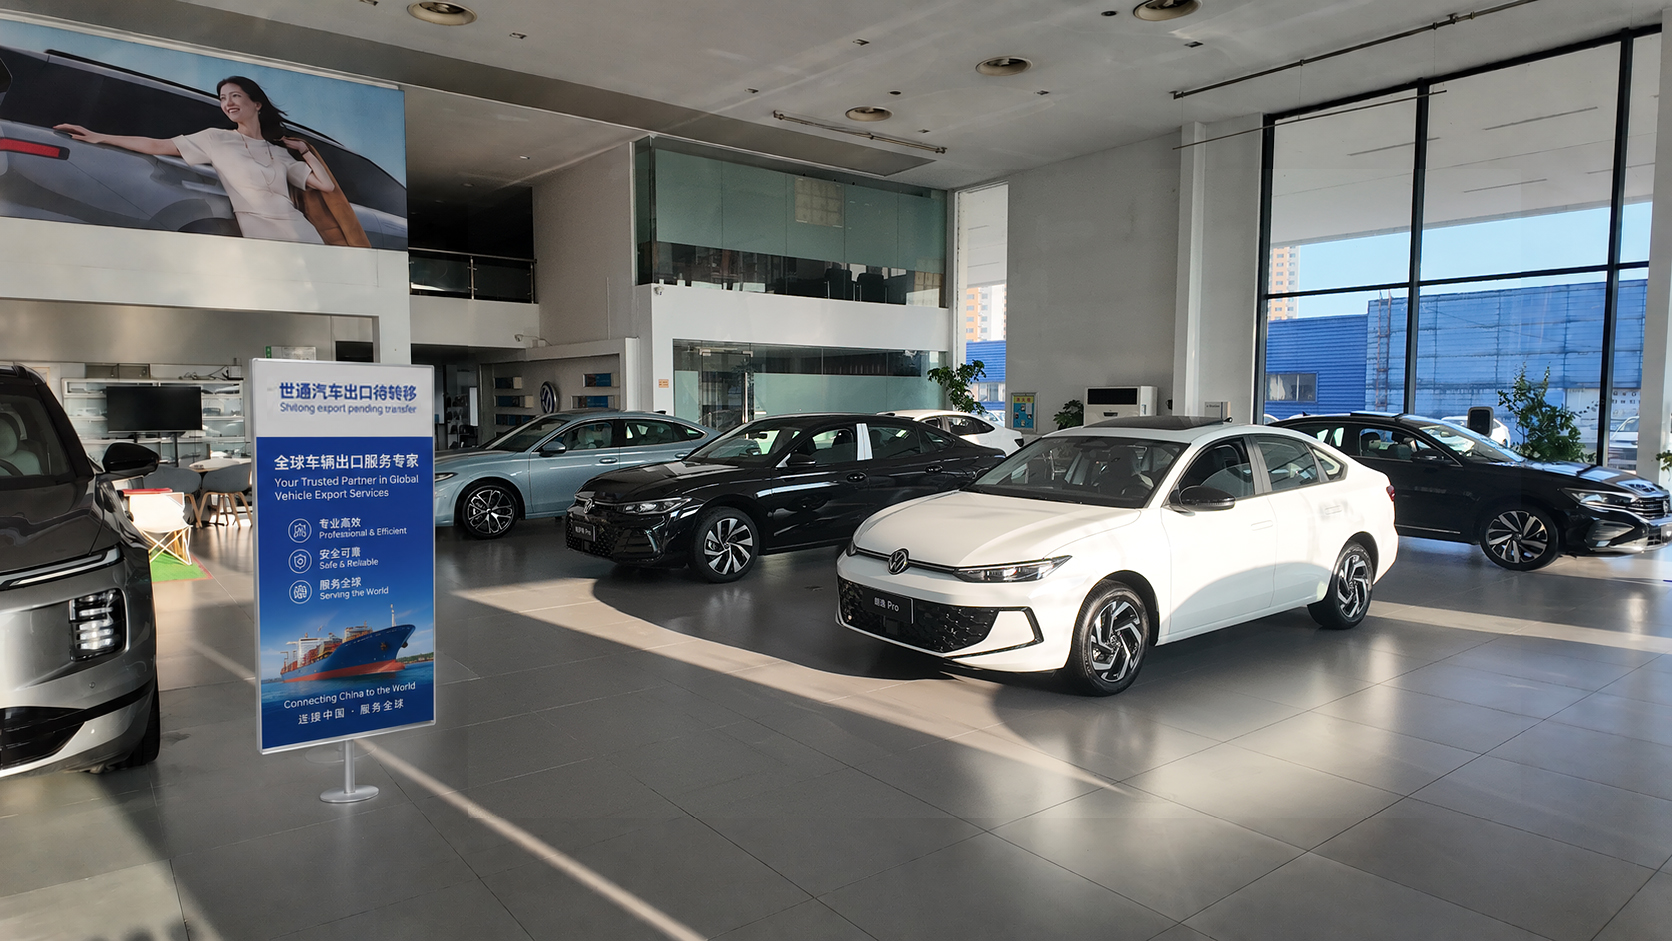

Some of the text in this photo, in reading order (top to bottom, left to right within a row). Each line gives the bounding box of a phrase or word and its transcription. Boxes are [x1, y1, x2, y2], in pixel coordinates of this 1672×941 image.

[279, 382, 417, 401] 世通汽车出口待转移
[317, 404, 346, 414] export
[349, 404, 383, 416] pending
[385, 405, 417, 414] transfer
[274, 453, 419, 470] 全球车辆出口服务专家
[275, 474, 419, 488] Your Trusted Partner in Global
[275, 488, 389, 501] Vehicle Export Services
[319, 517, 361, 529] 专业高效
[319, 529, 368, 539] Professional
[377, 527, 407, 536] Efficient
[319, 558, 379, 570] Safe & Reliable
[319, 576, 362, 591] 服务全球
[320, 586, 389, 600] Serving the World
[887, 600, 900, 612] Pro
[283, 681, 416, 709] Connecting China to the World
